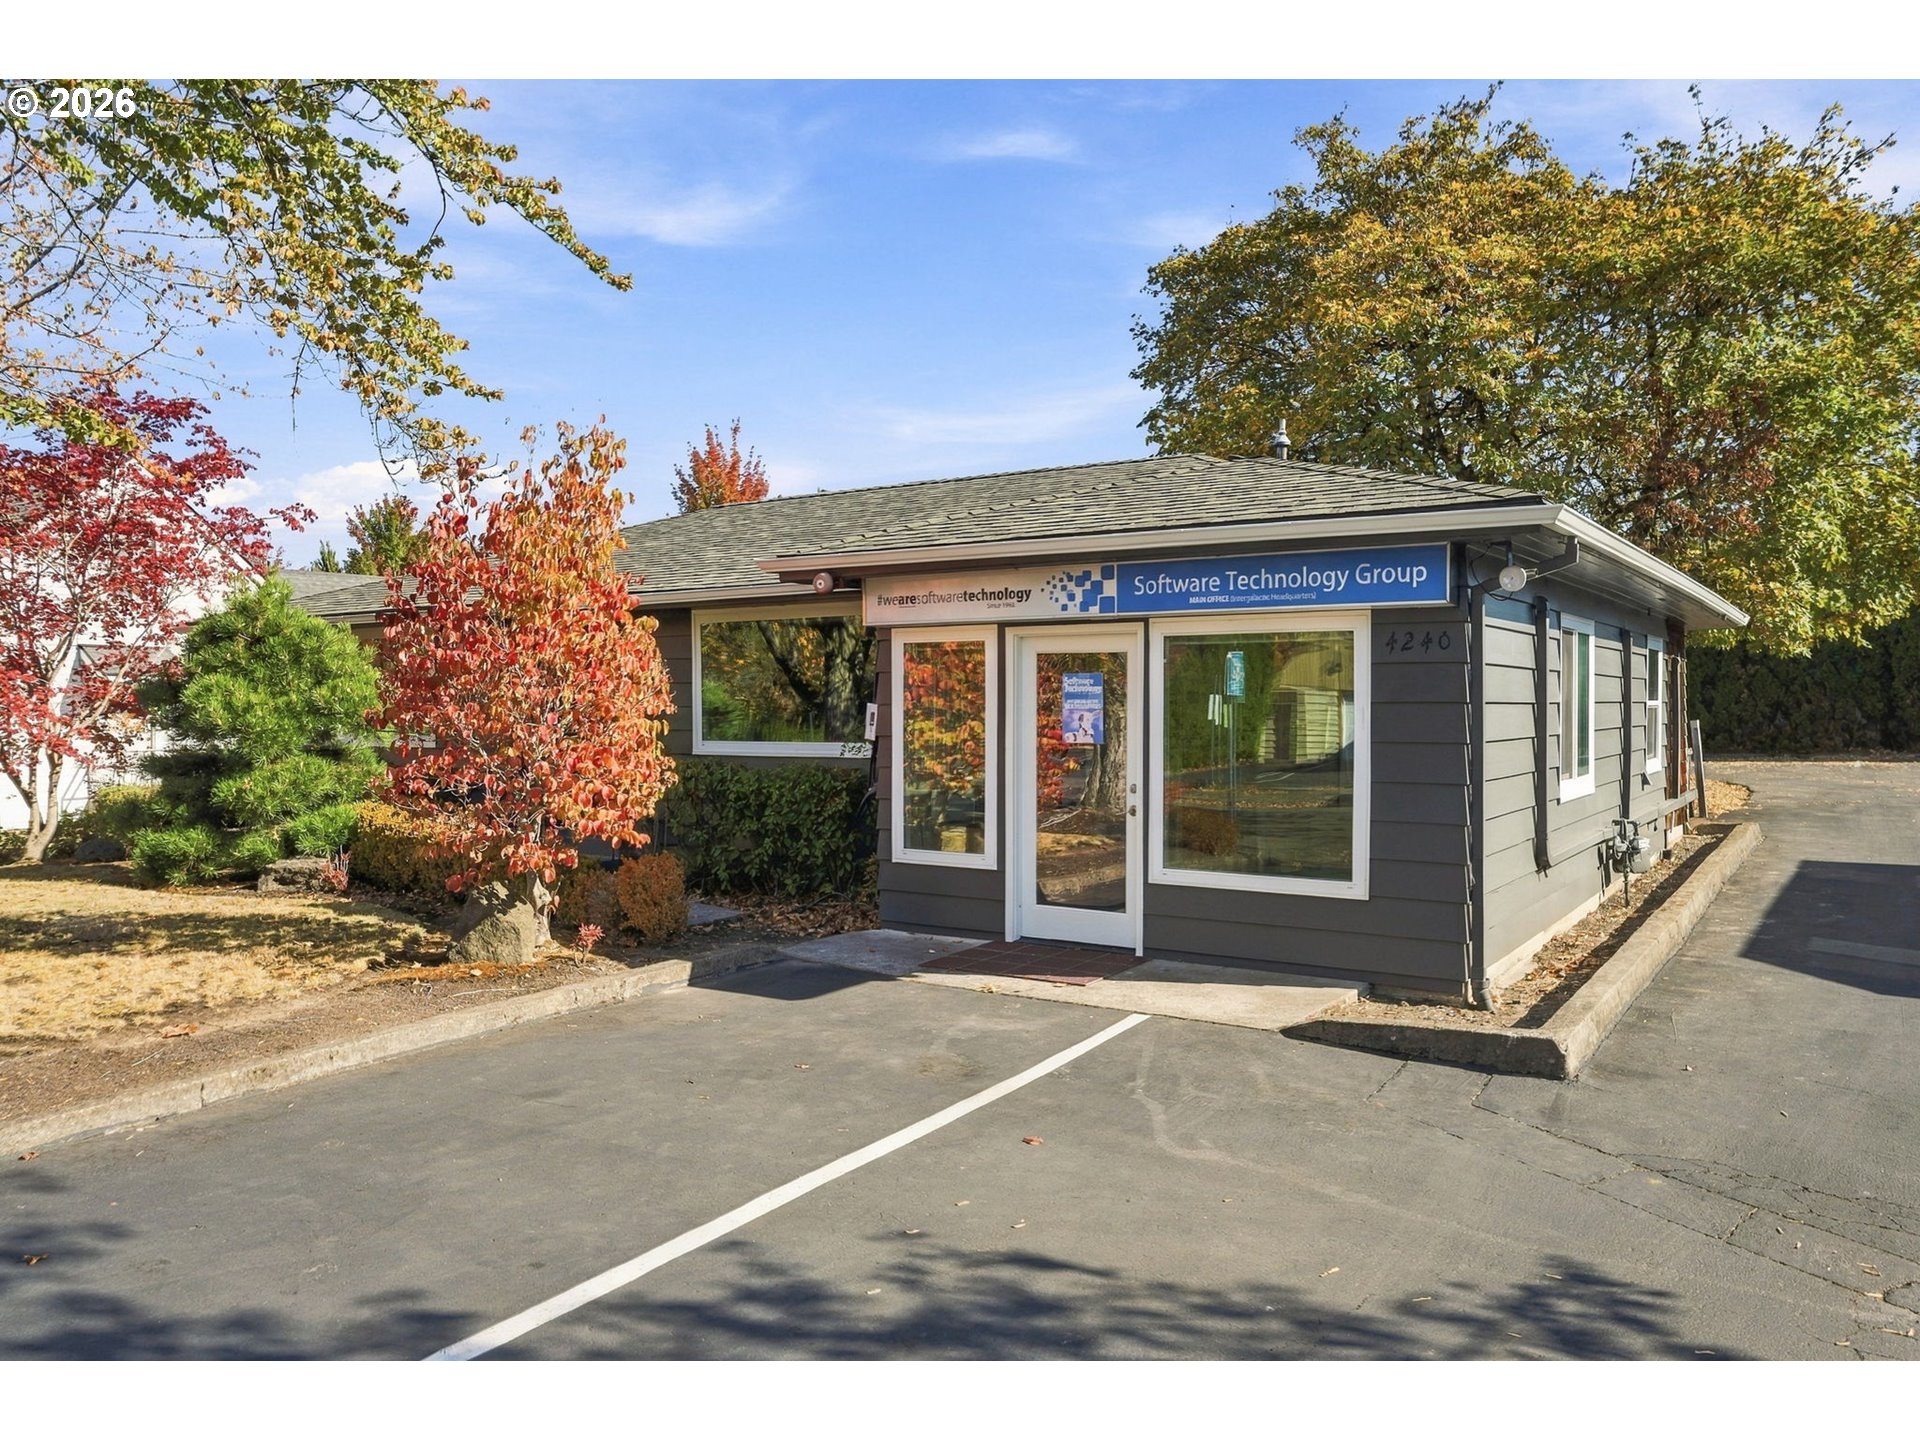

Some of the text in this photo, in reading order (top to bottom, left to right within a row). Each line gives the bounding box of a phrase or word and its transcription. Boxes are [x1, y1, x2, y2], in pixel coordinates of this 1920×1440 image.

[1134, 563, 1428, 595] Software Technology Group
[877, 587, 1032, 607] #wearesoftwaretechnology
[1189, 596, 1207, 604] MAIN
[1206, 595, 1230, 603] OFFICE
[1385, 630, 1451, 655] 4240
